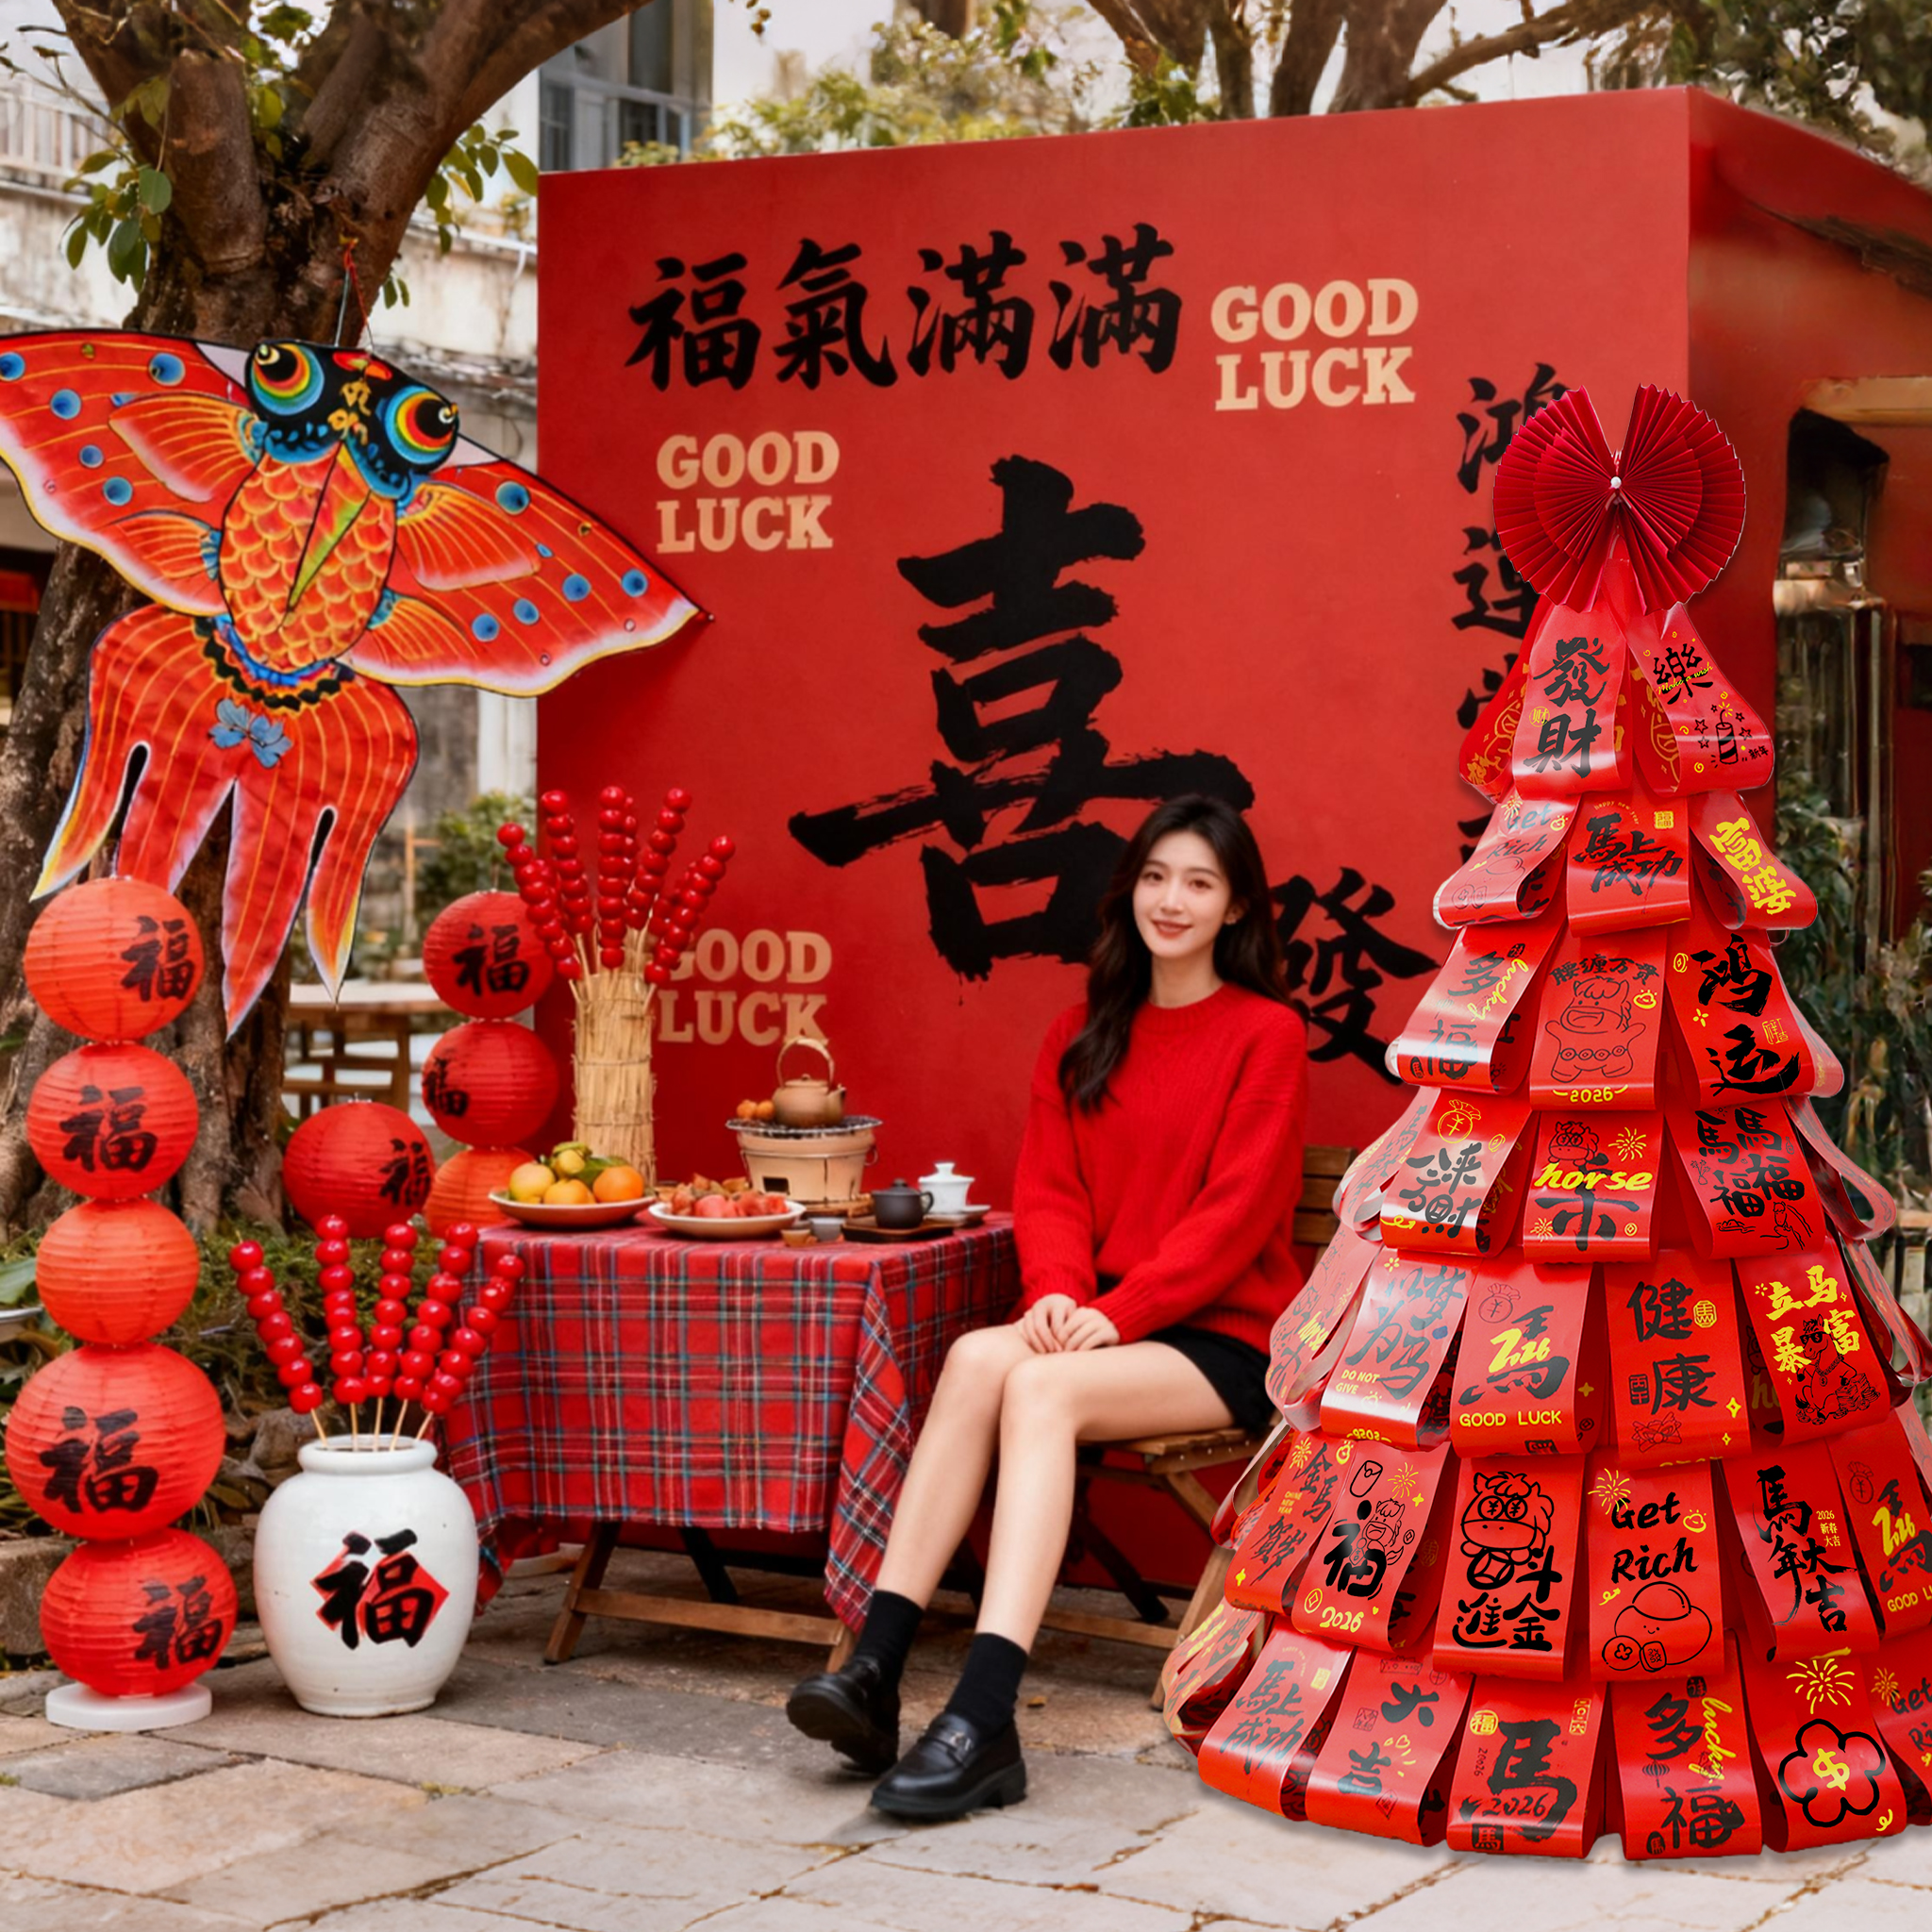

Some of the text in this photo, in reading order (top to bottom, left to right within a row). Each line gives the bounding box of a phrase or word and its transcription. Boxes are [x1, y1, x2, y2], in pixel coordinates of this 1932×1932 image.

[624, 223, 1182, 391] 福氣滿滿
[1211, 278, 1418, 342] GOOD
[1215, 346, 1415, 411] LUCK
[657, 431, 840, 489] GOOD
[657, 496, 833, 554] LUCK
[1653, 643, 1714, 706] 樂
[1656, 677, 1684, 695] Make
[1693, 661, 1713, 677] wish
[789, 454, 1256, 981] 喜
[1523, 637, 1610, 779] 發財
[1747, 745, 1769, 760] 新年
[1487, 834, 1547, 859] Rich
[1573, 812, 1667, 864] 馬上
[1591, 850, 1683, 897] 成功
[121, 915, 195, 1003] 福
[452, 923, 530, 996] 福
[1549, 953, 1660, 987] 腰缠万贯
[1467, 958, 1528, 1023] lucky
[658, 991, 828, 1046] LUCK
[1570, 1086, 1614, 1103] 2026
[59, 1084, 158, 1173] 福
[1534, 1162, 1654, 1191] horse
[1766, 1265, 1839, 1321] 立马
[1489, 1328, 1552, 1374] 2026
[1626, 1278, 1718, 1416] 健康
[1771, 1309, 1860, 1374] 暴富
[1335, 1382, 1359, 1394] GIVE
[1341, 1369, 1380, 1384] DO NOT
[1459, 1409, 1562, 1427] GOOD LUCK
[40, 1406, 158, 1514] 福
[1611, 1491, 1681, 1529] Get
[1816, 1509, 1835, 1520] 2026
[1872, 1507, 1916, 1557] 2026
[1611, 1537, 1699, 1585] Rich
[1824, 1535, 1840, 1547] 大吉
[314, 1528, 435, 1650] 福
[1888, 1591, 1919, 1612] GOOD
[134, 1575, 223, 1671] 福
[1320, 1606, 1365, 1633] 2026
[1890, 1677, 1932, 1715] Get
[1470, 1710, 1498, 1736] 福
[1459, 1719, 1578, 1842] 馬
[1644, 1692, 1745, 1850] 多福
[1482, 1792, 1550, 1817] 2026
[1474, 1824, 1503, 1850] 馬
